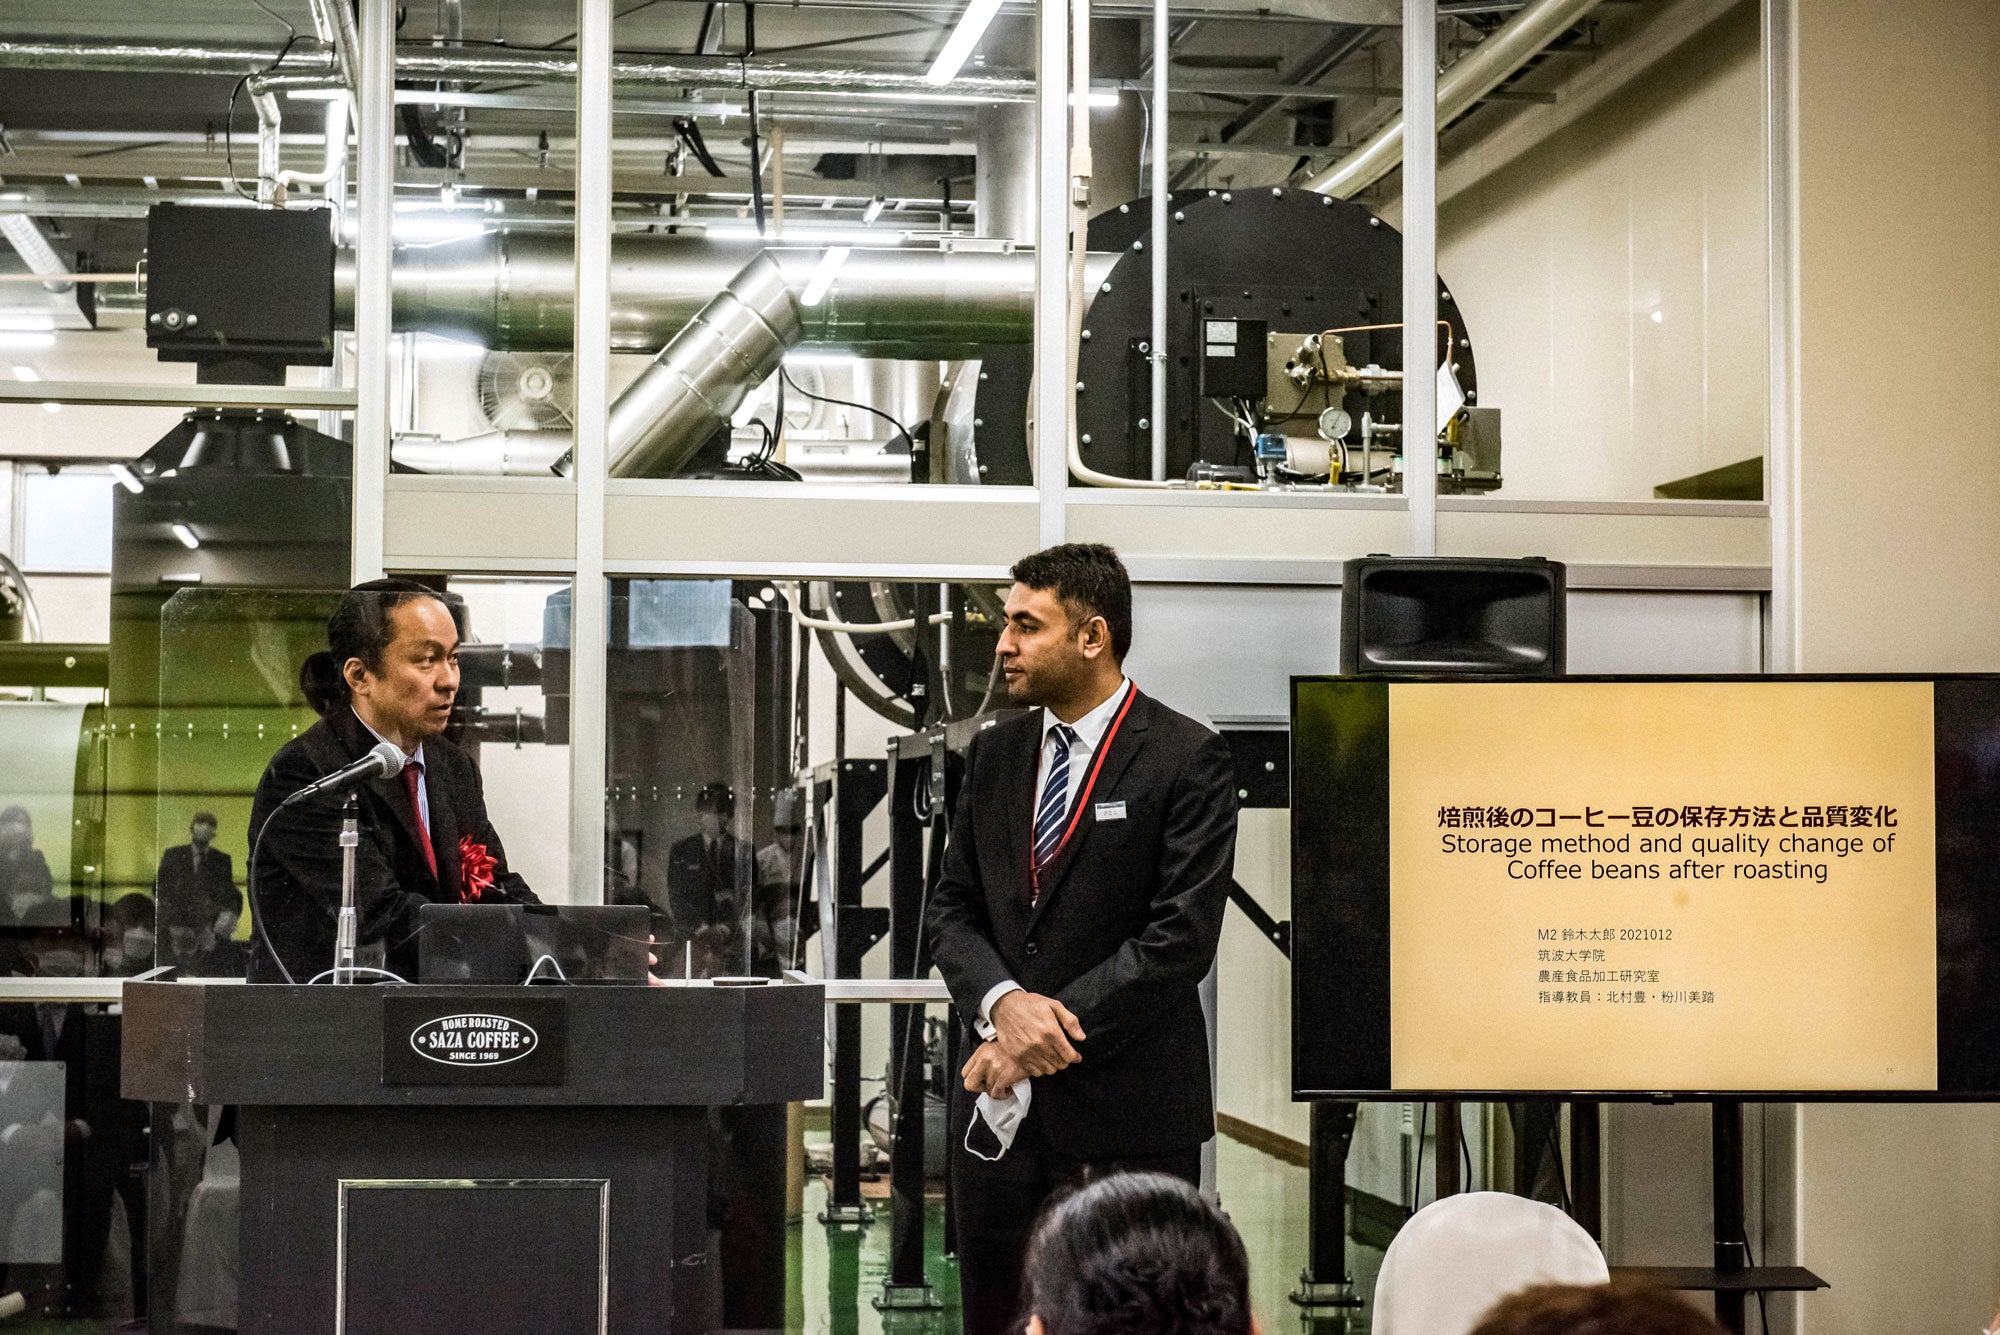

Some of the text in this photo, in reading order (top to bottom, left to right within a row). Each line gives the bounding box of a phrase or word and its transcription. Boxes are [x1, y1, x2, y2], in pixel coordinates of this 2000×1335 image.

[1437, 805, 1898, 829] 焙煎後のコーヒー豆の保存方法と品質変化
[1441, 833, 1897, 858] Storage method and quality change of
[1507, 859, 1828, 884] Coffee beans after roasting
[1537, 928, 1673, 942] M2 鈴木太郎 2021012
[1537, 948, 1606, 963] 筑波大学院
[1537, 969, 1660, 983] 農産食品加工研究室
[442, 1018, 510, 1032] HOME ROASTED
[429, 1031, 520, 1049] SAZA COFFEE
[449, 1052, 499, 1060] SINCE 1969
